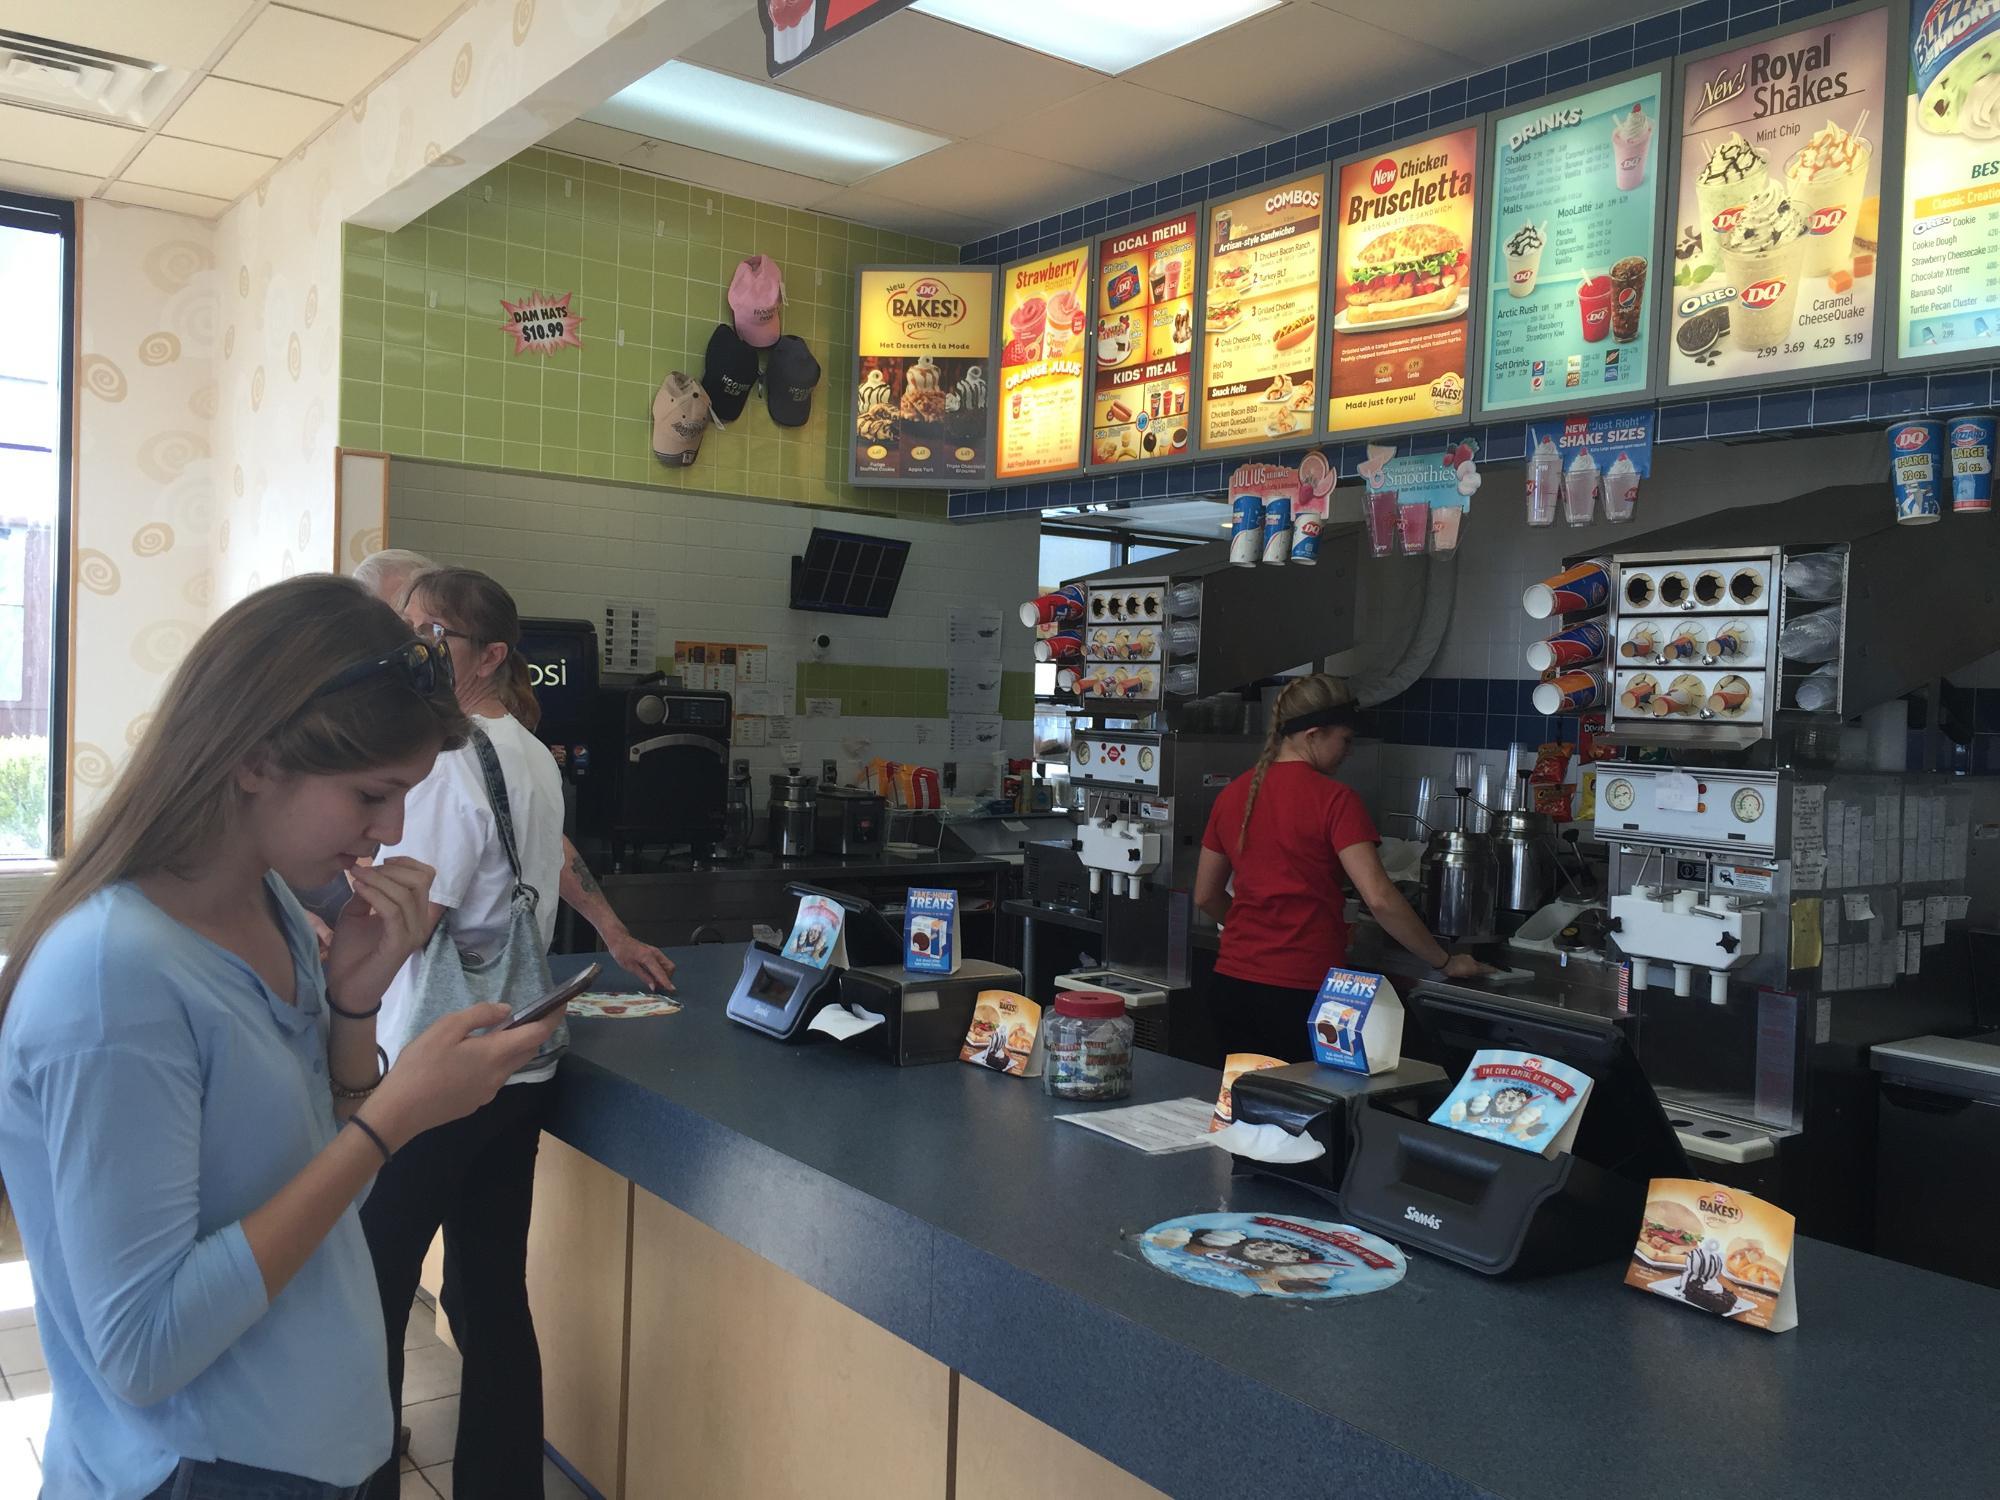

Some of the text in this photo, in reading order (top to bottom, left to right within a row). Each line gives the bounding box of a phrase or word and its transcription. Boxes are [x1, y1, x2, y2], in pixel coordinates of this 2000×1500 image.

[1751, 33, 1832, 87] Royal
[1700, 63, 1747, 106] New!
[1753, 71, 1848, 119] Shakes
[1509, 107, 1583, 153] DRINKS
[1756, 122, 1801, 143] Mint Chip
[1505, 153, 1532, 165] Shakes
[1373, 153, 1448, 187] New Chicken
[1971, 160, 2000, 179] BES
[1265, 191, 1320, 215] COMBOS
[1347, 170, 1473, 226] Bruschetta
[1415, 204, 1453, 218] SANDWICH
[1502, 205, 1523, 216] Malts
[1813, 210, 1843, 230] DQ
[1913, 215, 1976, 236] OREO Cookie
[1113, 234, 1148, 254] LOCAL
[1218, 225, 1296, 253] Artisan-style Sandwiches
[1912, 235, 1957, 251] Cookie Dough
[1254, 252, 1258, 262] 1
[1260, 251, 1279, 261] Chicken
[1280, 246, 1295, 256] Bacon
[1295, 241, 1311, 251] Ranch
[1912, 246, 1986, 267] Strawberry Cheesecake
[1016, 258, 1079, 289] Strawberry
[1253, 273, 1258, 283] 2
[1516, 271, 1532, 281] DQ
[1911, 265, 1970, 283] Chocolate Xtreme
[886, 282, 905, 293] New
[920, 285, 936, 294] DQ
[1119, 281, 1131, 293] DQ
[1747, 282, 1781, 303] DQ
[1910, 284, 1953, 298] Banana Split
[892, 299, 958, 318] BAKES!
[1252, 306, 1256, 316] 3
[1275, 301, 1296, 312] Chicken
[1680, 286, 1738, 315] OREO
[1813, 294, 1853, 311] Caramel
[1910, 296, 1978, 315] Turtle Pecan Cluster
[513, 306, 568, 323] DAM HATS
[1497, 304, 1538, 319] Arctic Rush
[1590, 311, 1606, 322] DQ
[1799, 307, 1865, 327] CheeseQuake
[522, 322, 564, 343] $10.99
[1215, 337, 1219, 348] 4
[1233, 335, 1251, 345] Cheese
[1252, 333, 1261, 343] Dog
[1757, 332, 1864, 359] 2.99 3.69 4.29 5.19
[1113, 361, 1178, 384] KIDS' MEAL
[1495, 359, 1530, 371] Soft Drinks
[1005, 360, 1082, 391] ORANGE JULIUS
[1212, 384, 1247, 398] Snack Melts
[1431, 386, 1461, 401] BAKES!
[1345, 393, 1416, 410] Made just for you!
[1211, 409, 1230, 419] Chicken
[1231, 407, 1245, 417] Bacon
[1211, 415, 1256, 429] Chicken Quesadilla
[1228, 426, 1247, 437] Chicken
[1565, 423, 1587, 433] NEW
[1559, 427, 1646, 448] SHAKE SIZES
[1900, 432, 1924, 446] DQ
[1953, 447, 1984, 459] LARGE
[1233, 468, 1266, 488] JULIUS
[1386, 465, 1456, 486] Smoothies
[1903, 471, 1913, 481] 32
[1305, 524, 1320, 533] DQ
[910, 896, 954, 910] TREATS
[913, 890, 953, 899] TAKE-HOME
[1332, 972, 1378, 985] TAKE-HOME
[1326, 977, 1377, 999] TREATS
[1482, 1067, 1494, 1075] THE
[1495, 1067, 1509, 1075] CONE
[1510, 1068, 1532, 1079] CAPITAL
[1541, 1076, 1553, 1085] THE
[1551, 1081, 1568, 1094] WORLD
[1480, 1116, 1512, 1124] OREO
[1700, 1199, 1738, 1220] BAKES!
[1205, 1251, 1265, 1272] OREO
